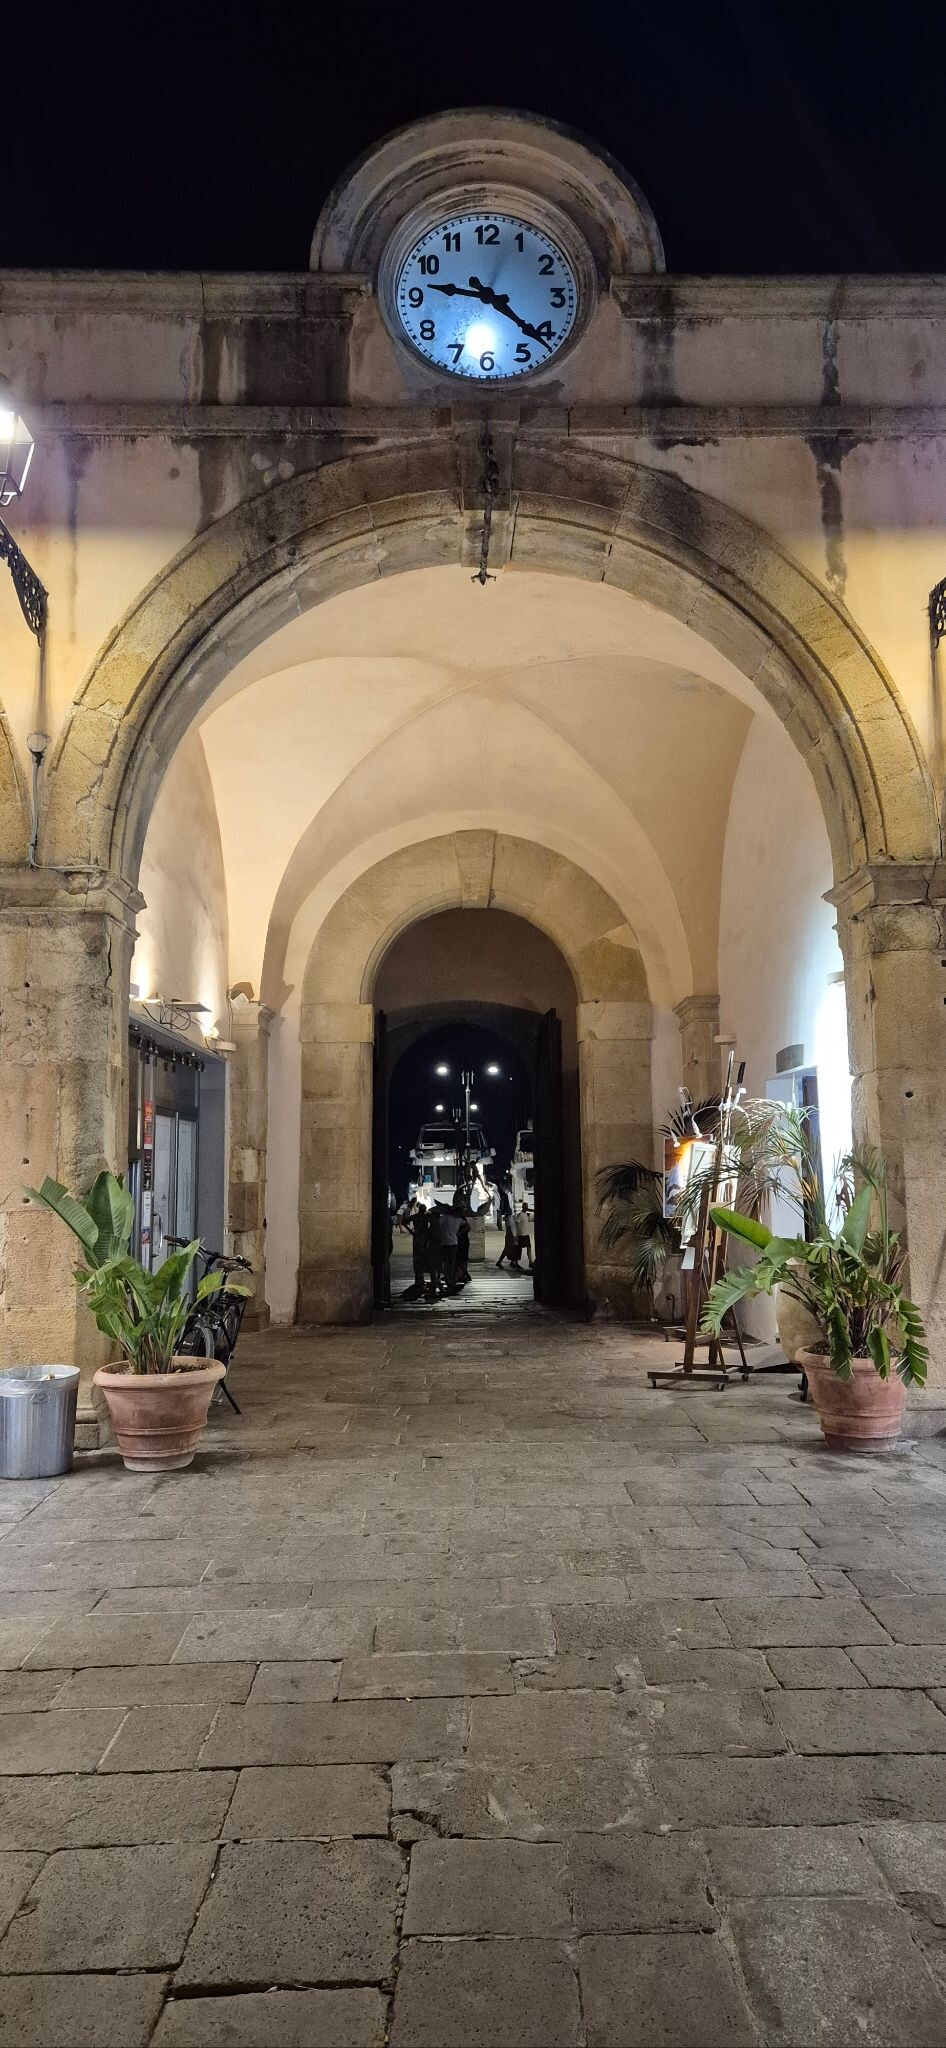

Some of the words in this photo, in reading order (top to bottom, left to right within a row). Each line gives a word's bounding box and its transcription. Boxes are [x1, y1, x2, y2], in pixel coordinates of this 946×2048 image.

[442, 232, 461, 252] 11
[474, 224, 500, 245] 12
[515, 232, 524, 252] 1
[417, 254, 440, 275] 10
[538, 254, 555, 275] 2
[408, 287, 424, 308] 9
[550, 287, 566, 308] 3
[420, 320, 435, 340] 8
[535, 320, 556, 341] 4
[447, 344, 465, 364] 7
[480, 351, 495, 371] 6
[513, 343, 531, 363] 5
